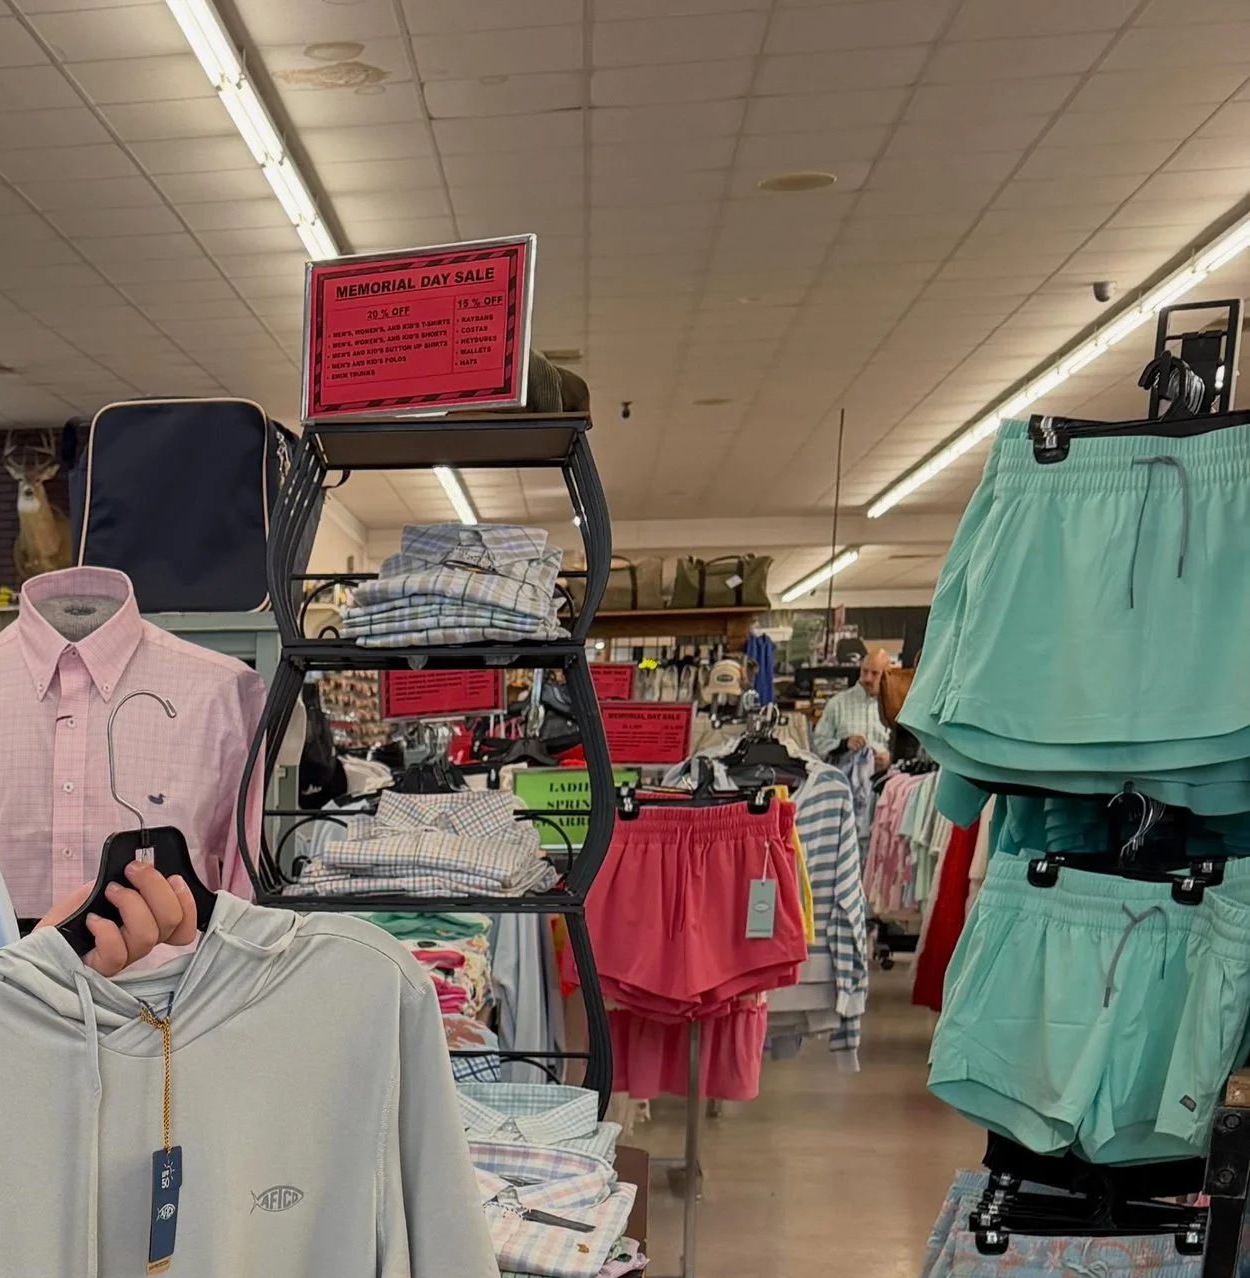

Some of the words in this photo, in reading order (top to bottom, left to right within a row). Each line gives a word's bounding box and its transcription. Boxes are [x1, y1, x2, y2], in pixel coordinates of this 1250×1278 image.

[336, 278, 415, 299] MEMORIAL
[420, 273, 451, 288] DAY
[454, 267, 495, 283] SALE
[457, 298, 469, 308] 15
[472, 298, 481, 307] %
[483, 296, 503, 306] OFF
[367, 309, 378, 319] 20
[381, 309, 389, 318] %
[392, 306, 410, 316] OFF
[162, 1178, 170, 1188] 50
[258, 1186, 301, 1211] AFTCO
